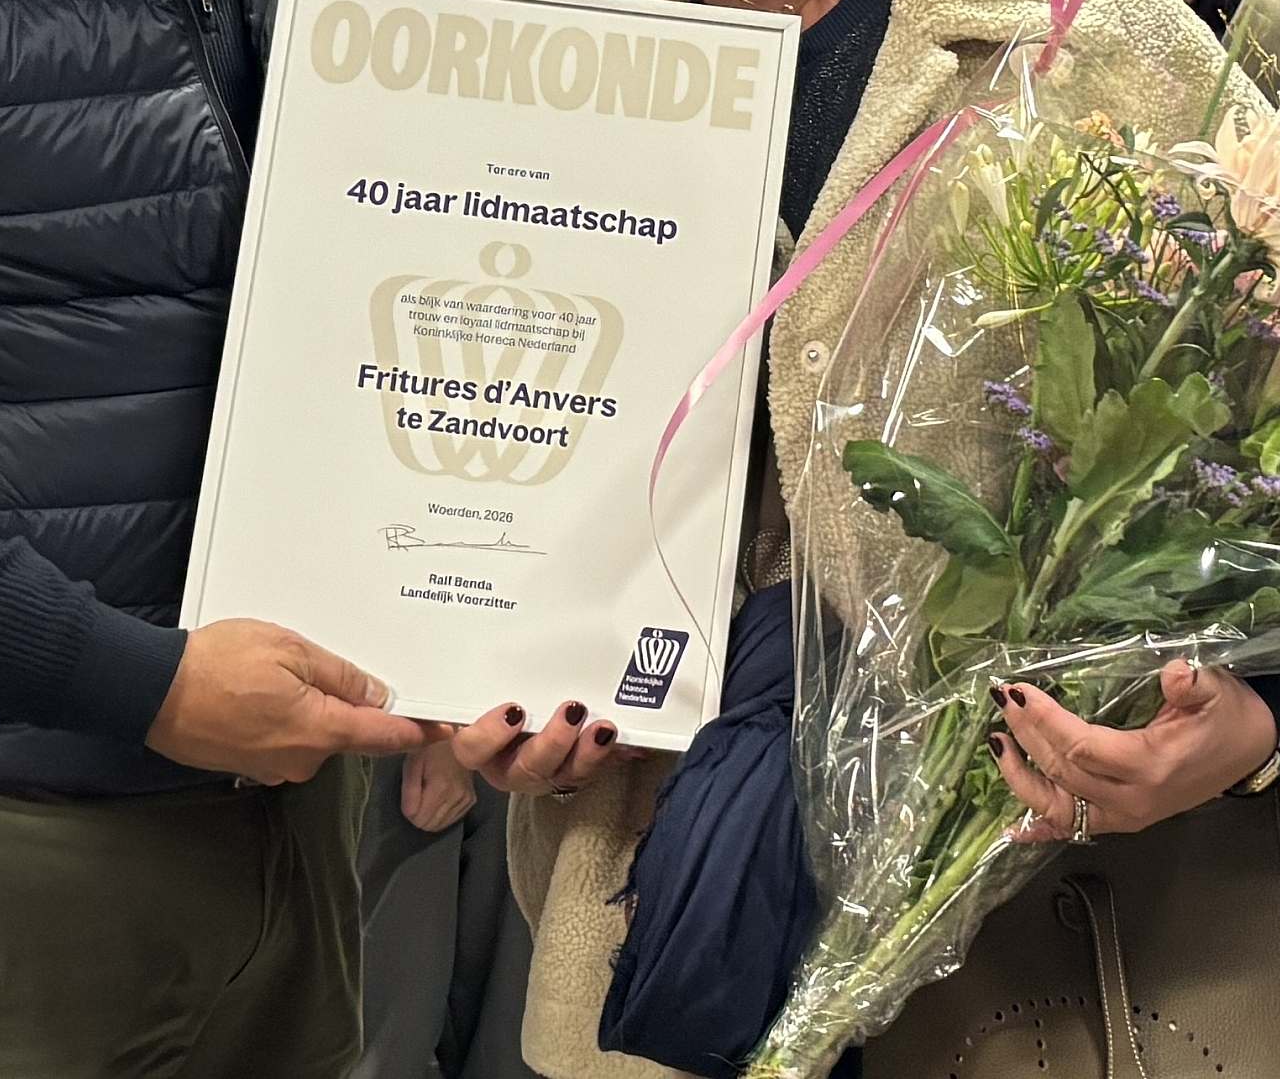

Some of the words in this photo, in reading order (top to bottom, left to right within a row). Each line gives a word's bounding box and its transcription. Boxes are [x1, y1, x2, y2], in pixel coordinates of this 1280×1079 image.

[310, 0, 760, 130] OORKONDE
[486, 163, 506, 175] Ter
[529, 170, 550, 180] van
[346, 178, 389, 205] 40
[392, 182, 458, 214] jaar
[463, 191, 677, 245] lidmaatschap
[400, 294, 417, 304] als
[418, 295, 441, 308] blijk
[443, 299, 464, 310] van
[466, 302, 528, 319] waardering
[531, 309, 556, 321] voor
[558, 311, 573, 323] 40
[575, 314, 597, 327] jaar
[408, 309, 441, 322] trouw
[443, 314, 458, 324] en
[460, 316, 493, 329] loyaal
[494, 319, 570, 339] lidmaatschap
[572, 327, 586, 341] bij
[413, 325, 473, 342] Koninklijke
[475, 332, 515, 347] Horeca
[517, 337, 577, 354] Nederland
[357, 364, 478, 401] Fritures
[396, 407, 423, 429] te
[428, 409, 569, 447] Zandvoort
[428, 503, 482, 520] Woerden,
[483, 509, 514, 523] 2026
[400, 585, 454, 604] Landelijk
[456, 592, 517, 610] Voorzitter
[429, 573, 452, 586] Ralf
[454, 576, 493, 591] Benda
